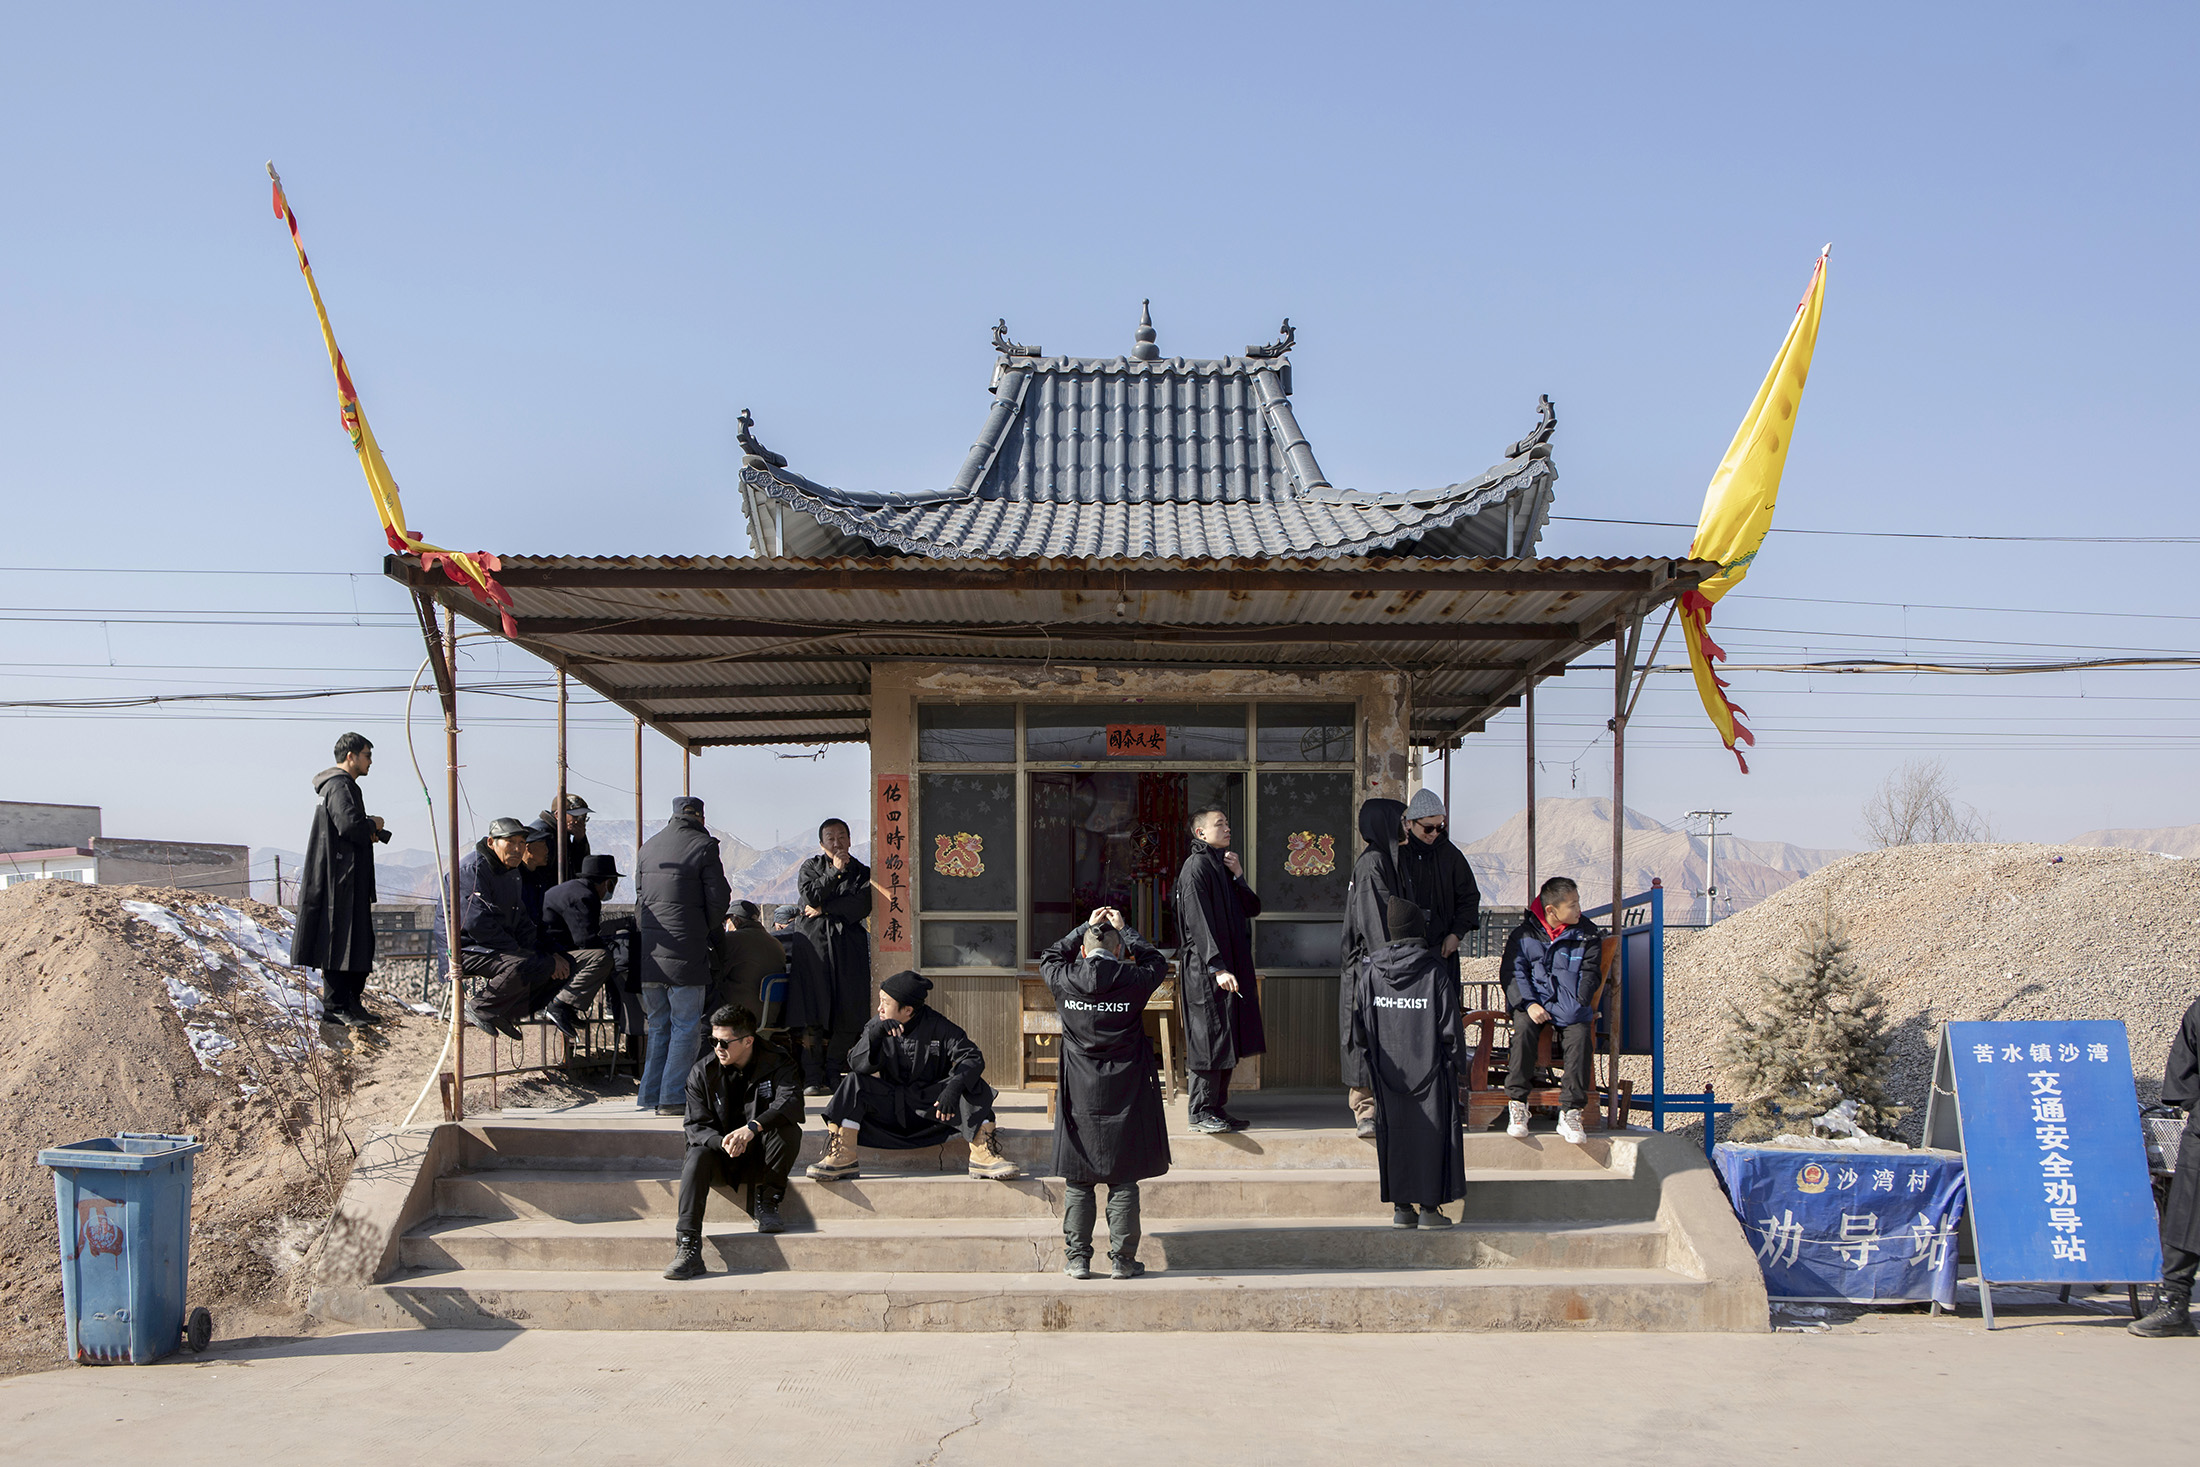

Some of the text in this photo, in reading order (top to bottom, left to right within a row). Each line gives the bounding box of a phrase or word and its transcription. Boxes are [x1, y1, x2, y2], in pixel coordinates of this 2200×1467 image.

[1064, 999, 1130, 1012] ARCH-EXIST
[1373, 996, 1428, 1009] ARCH-EXIST
[1973, 1043, 2109, 1063] 苦水镇沙湾
[2028, 1070, 2087, 1262] 交通安全劝导站
[1837, 1167, 1930, 1192] 沙湾村
[1757, 1208, 1949, 1272] 劝导站
